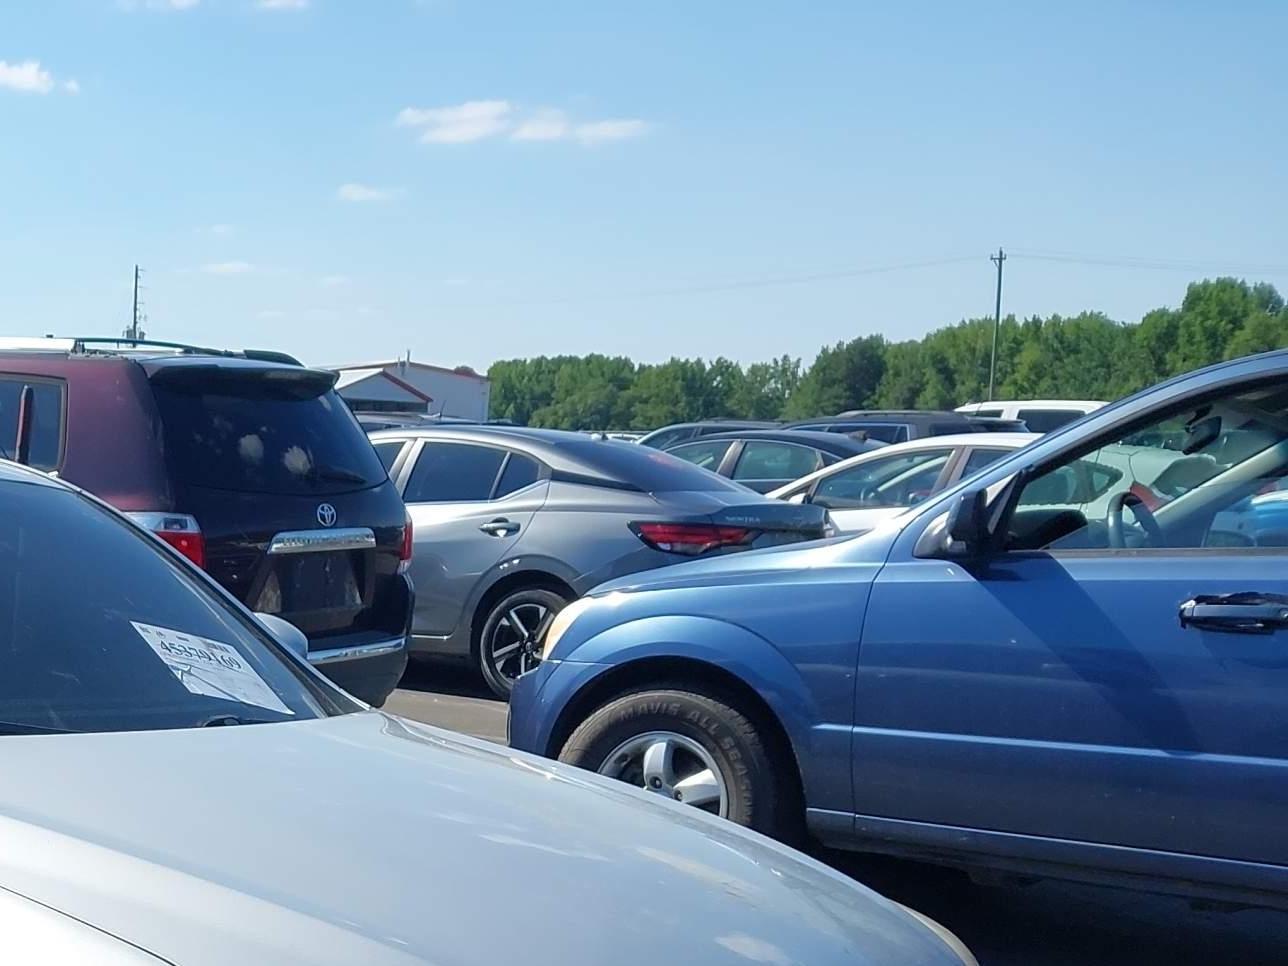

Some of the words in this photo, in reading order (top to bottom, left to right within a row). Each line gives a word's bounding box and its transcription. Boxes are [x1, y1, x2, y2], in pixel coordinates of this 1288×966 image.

[160, 640, 242, 671] 45379169
[620, 703, 681, 721] MAVIS
[687, 711, 720, 732] ALL
